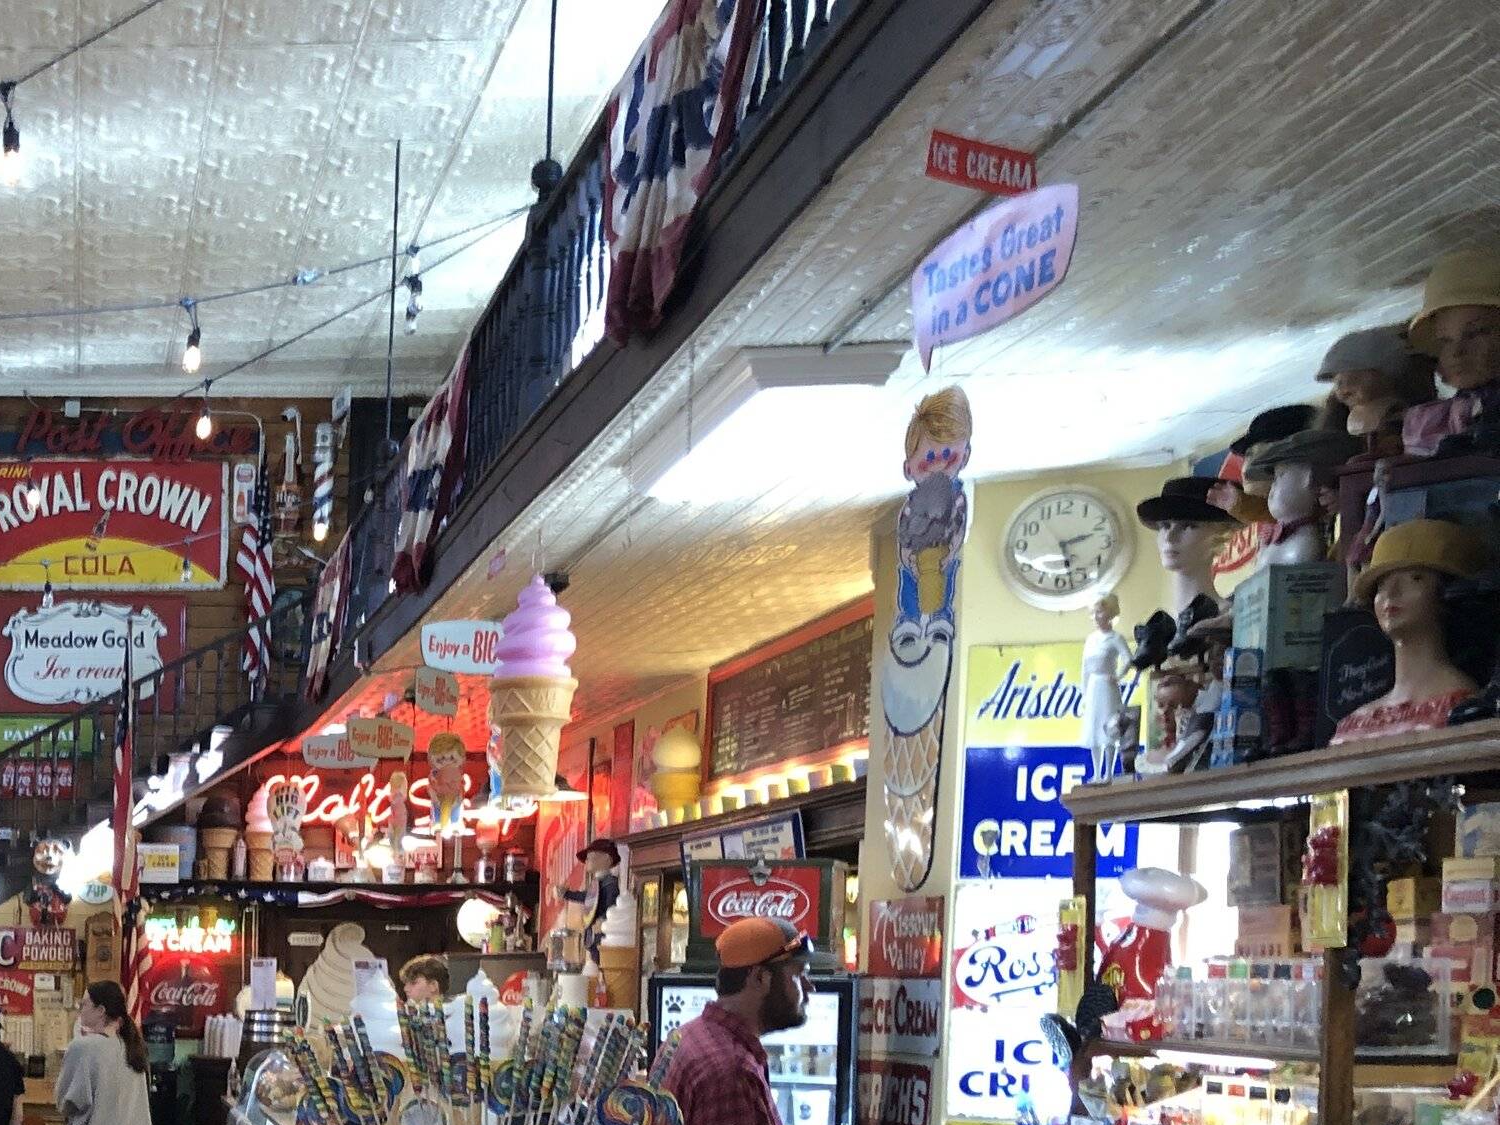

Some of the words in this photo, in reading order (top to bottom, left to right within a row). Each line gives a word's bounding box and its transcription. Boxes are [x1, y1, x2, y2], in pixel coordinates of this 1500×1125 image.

[931, 140, 958, 175] ICE
[966, 152, 1032, 189] CREAM
[924, 245, 992, 297] Tastes
[1000, 204, 1064, 260] Great
[932, 305, 949, 336] in
[956, 299, 968, 327] a
[974, 249, 1056, 316] CONE
[97, 469, 212, 533] CROWN
[1056, 499, 1075, 517] 12
[1021, 520, 1040, 537] 10
[63, 555, 136, 577] COLA
[24, 629, 98, 650] Meadow
[102, 629, 146, 650] God
[428, 634, 460, 660] Enjoy
[462, 643, 470, 655] a
[33, 653, 71, 681] Ice
[376, 724, 393, 750] BIG
[306, 743, 328, 761] Enjoy
[1015, 765, 1087, 803] ICE
[972, 818, 1126, 858] CREAM
[25, 929, 72, 945] BAKING
[22, 945, 74, 962] POWDER
[894, 985, 939, 1037] CREAM
[995, 1039, 1059, 1065] IC
